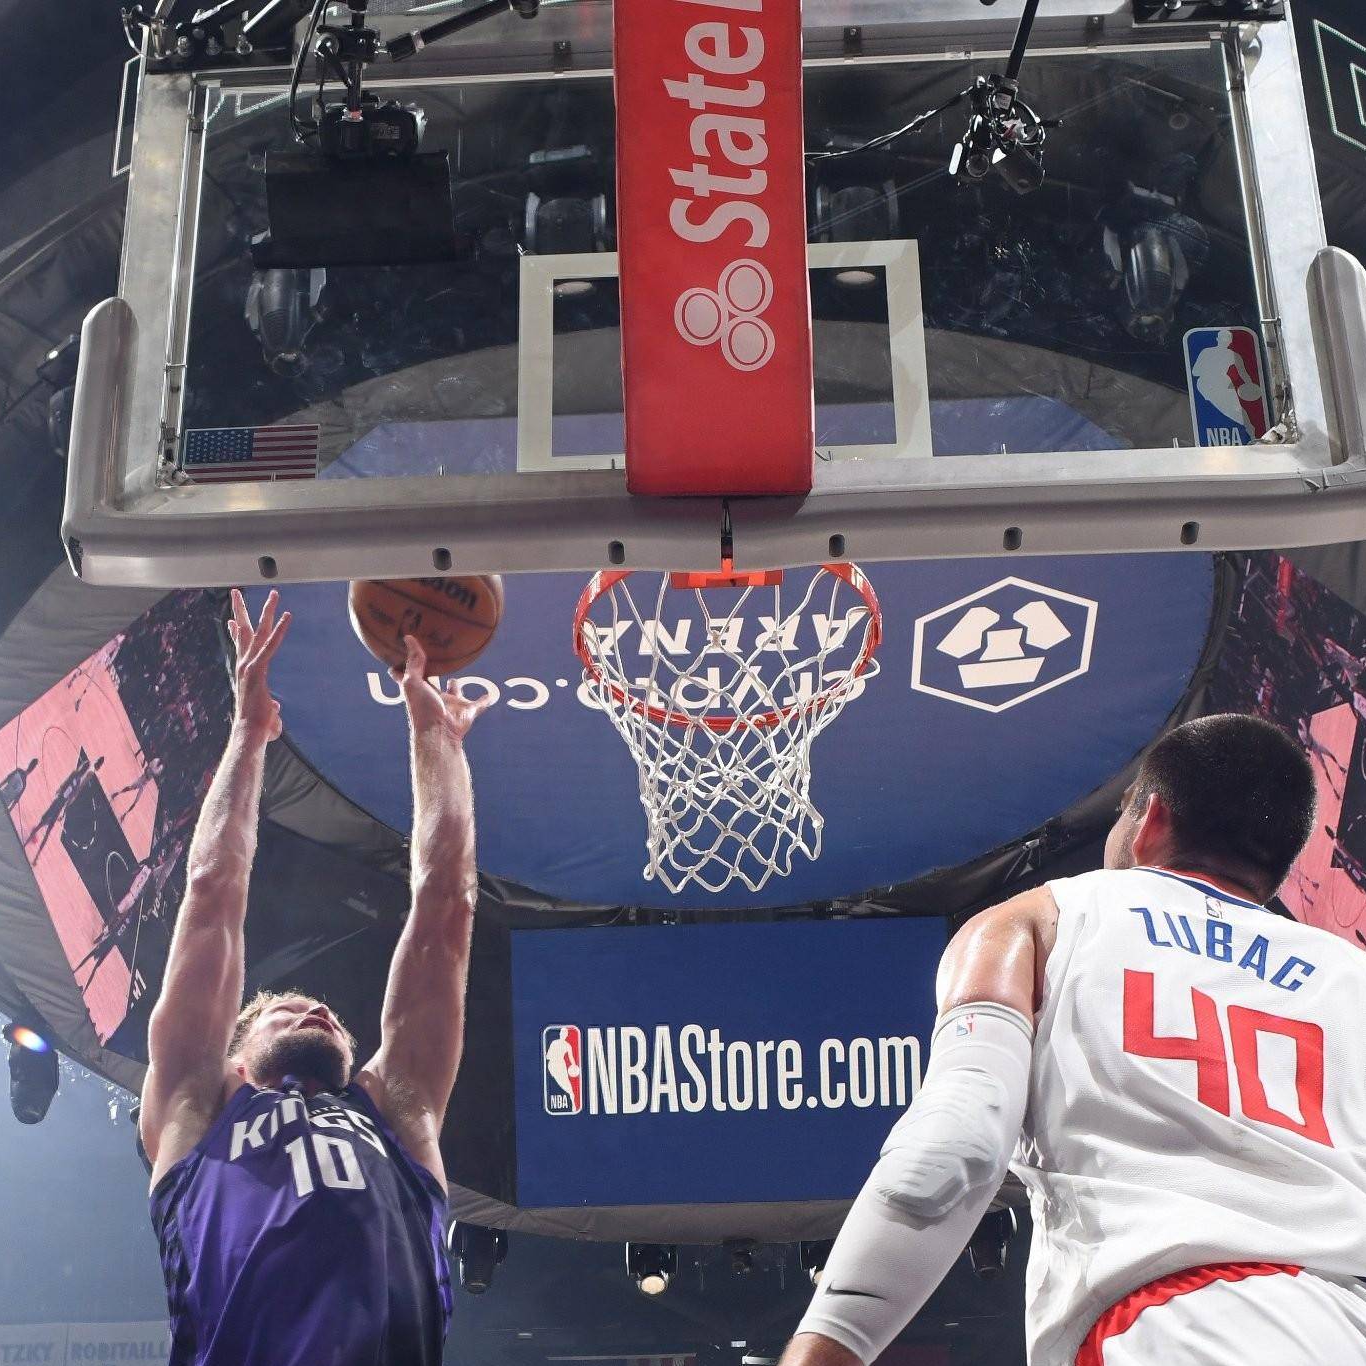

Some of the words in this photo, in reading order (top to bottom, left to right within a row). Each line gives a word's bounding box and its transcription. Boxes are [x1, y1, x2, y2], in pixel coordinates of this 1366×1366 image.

[586, 612, 870, 657] ARENA
[1129, 907, 1317, 993] ZUBAC
[587, 1023, 922, 1116] NBAStore.com
[1122, 968, 1335, 1149] 40
[550, 1094, 569, 1110] NBA
[285, 1133, 367, 1199] 10
